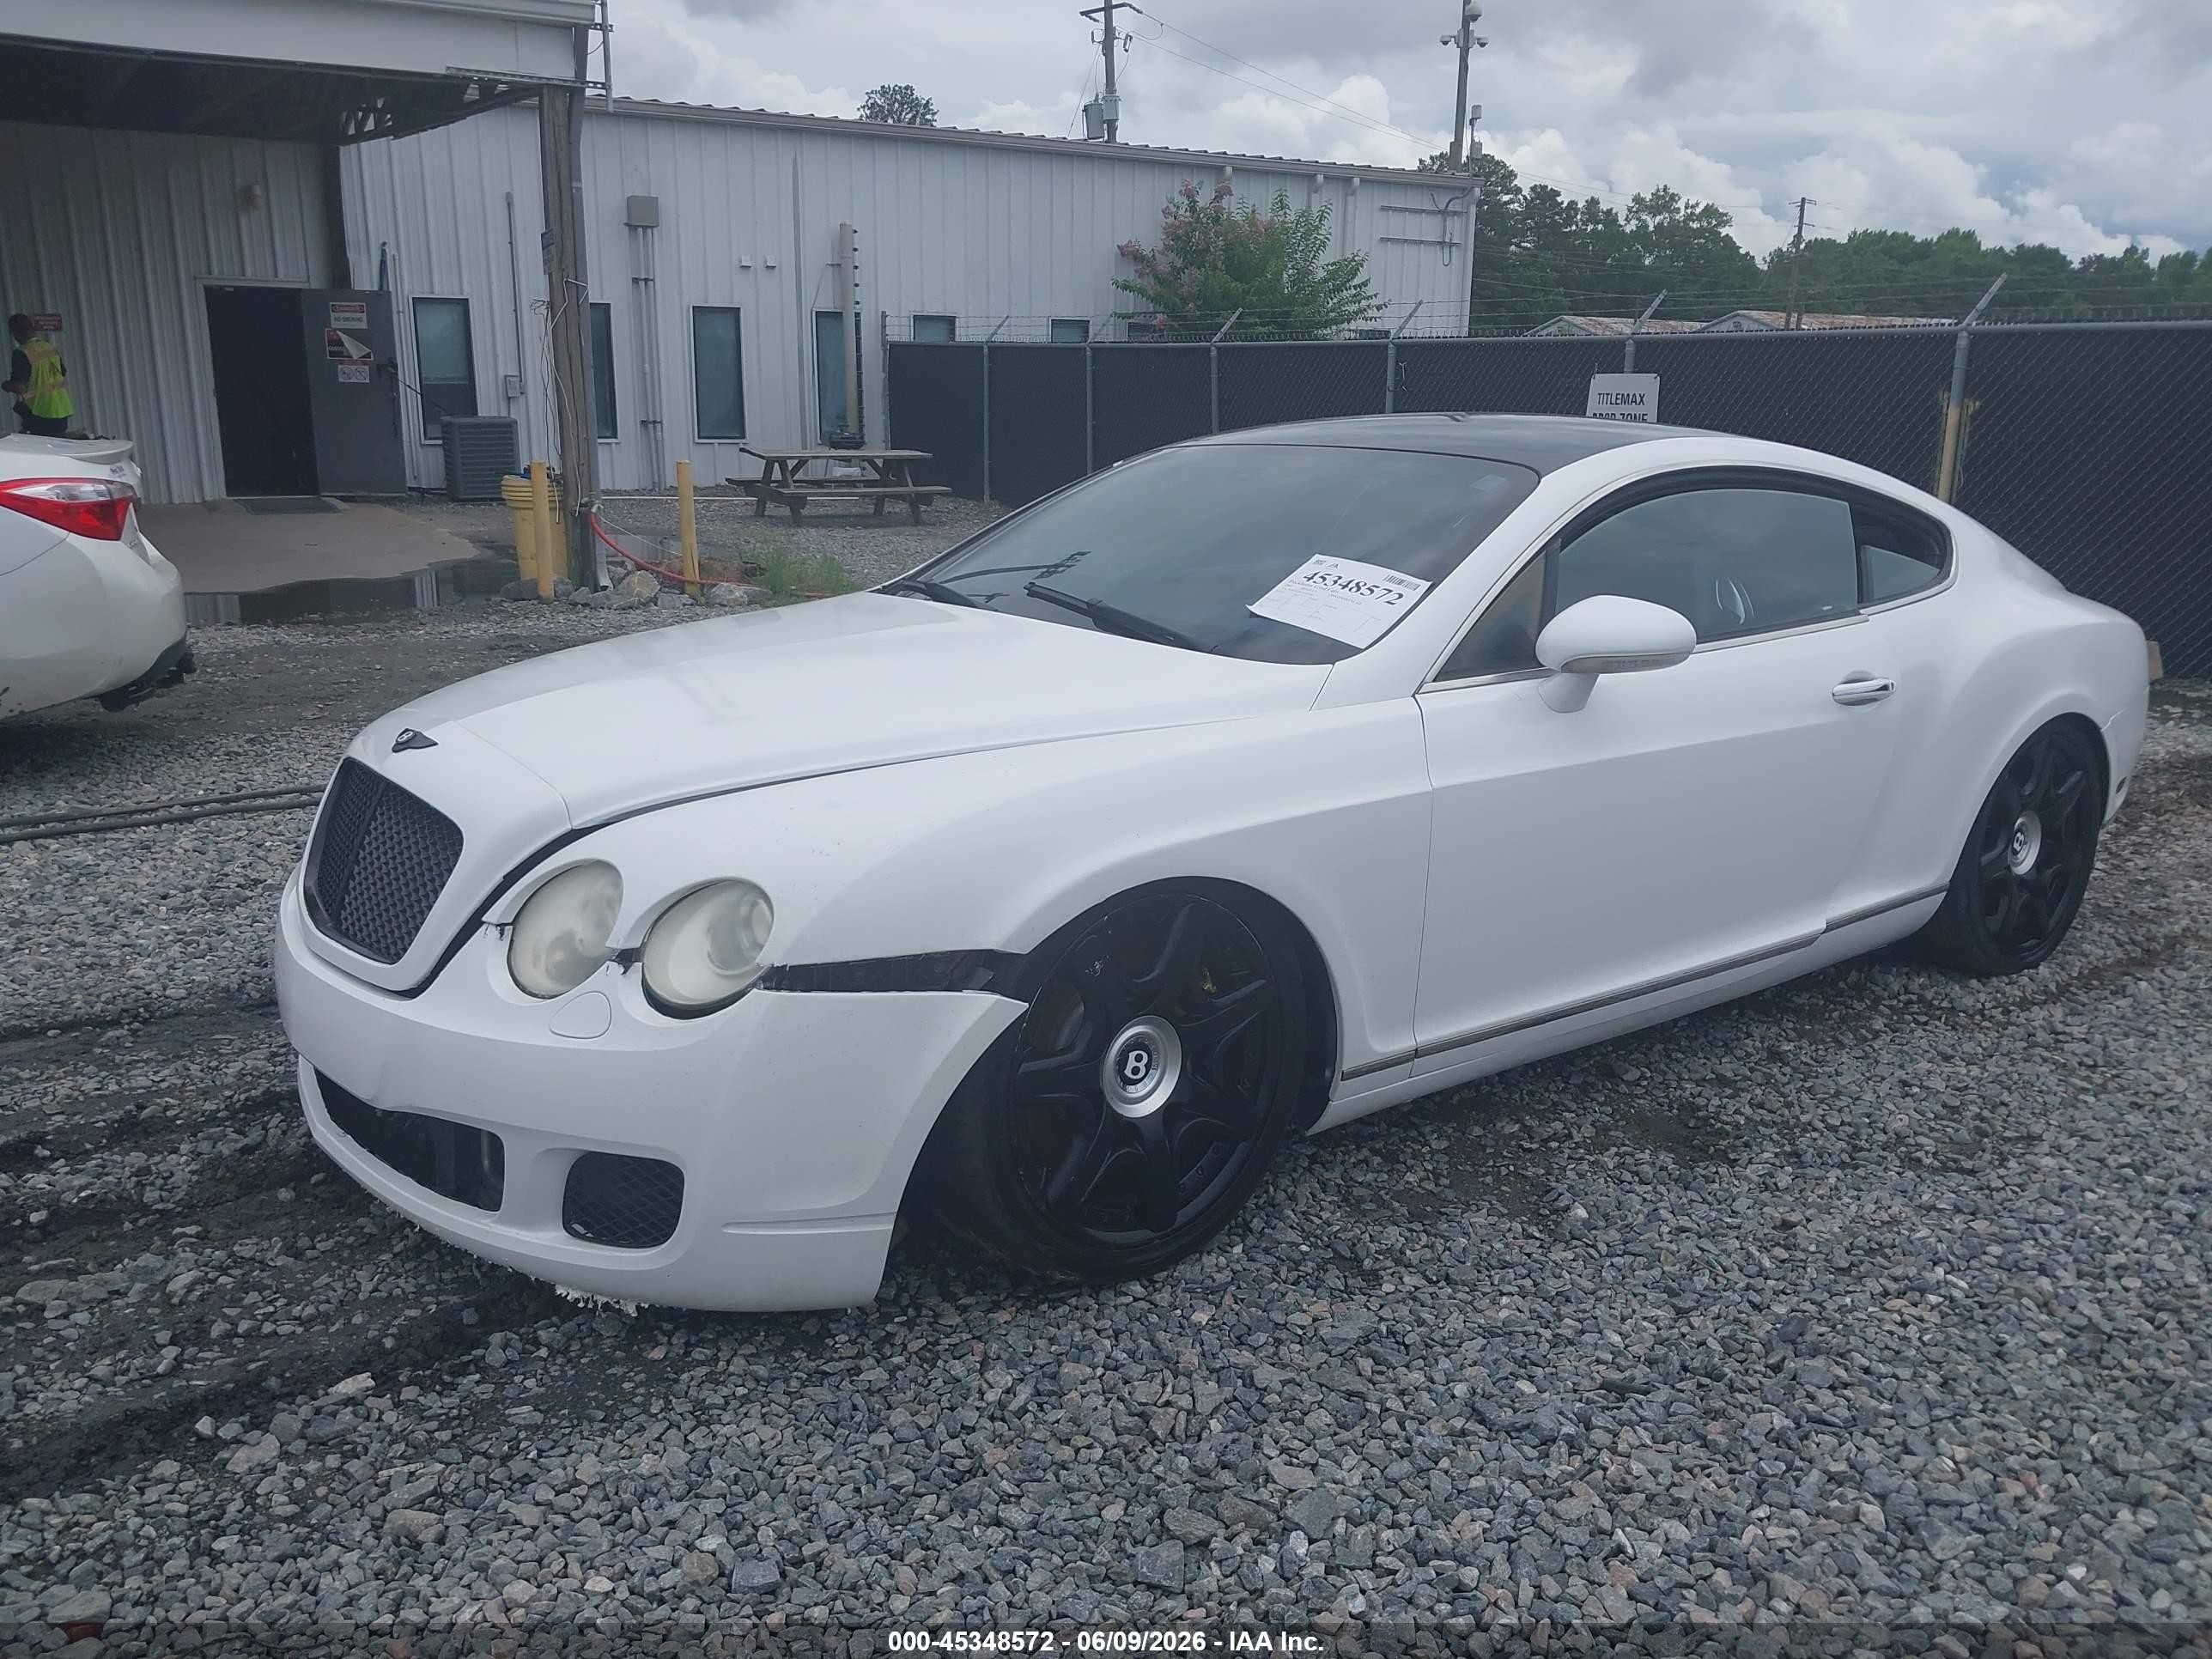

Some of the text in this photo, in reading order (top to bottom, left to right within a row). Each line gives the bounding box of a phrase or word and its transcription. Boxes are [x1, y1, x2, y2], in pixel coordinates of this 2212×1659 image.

[1597, 392, 1645, 406] TITLEMAX
[1302, 570, 1405, 606] 45348572
[1123, 1050, 1149, 1079] B
